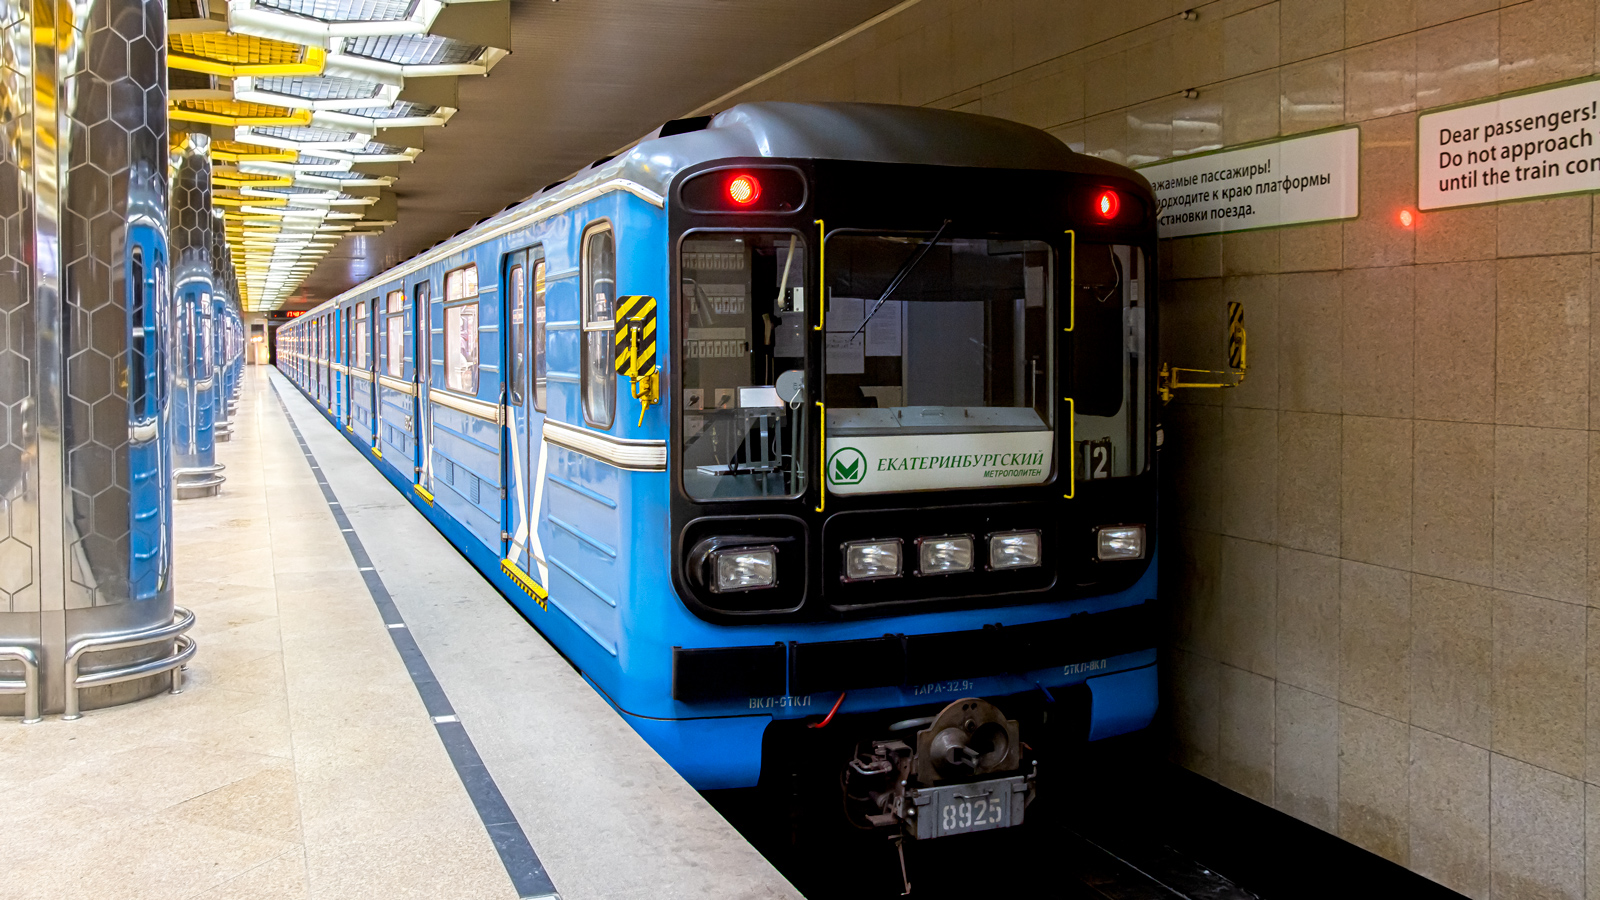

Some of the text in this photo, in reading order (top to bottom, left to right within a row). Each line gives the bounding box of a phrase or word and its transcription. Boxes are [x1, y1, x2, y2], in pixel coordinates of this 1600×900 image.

[1439, 100, 1597, 146] Dear passengers!
[1439, 127, 1593, 169] Do not approach
[1152, 159, 1271, 191] ажаемые пассажиры!
[1212, 189, 1219, 201] к
[1222, 184, 1252, 202] краю
[1255, 173, 1331, 195] платформы
[1439, 169, 1477, 192] until
[1482, 167, 1510, 187] the
[1515, 160, 1560, 182] train
[1158, 204, 1256, 226] становки поезда.
[877, 450, 1044, 472] ЕКАТЕРИНБУРГСКИЙ
[983, 468, 1042, 479] МЕТРОПОЛИТЕН
[942, 798, 1002, 831] 8925
